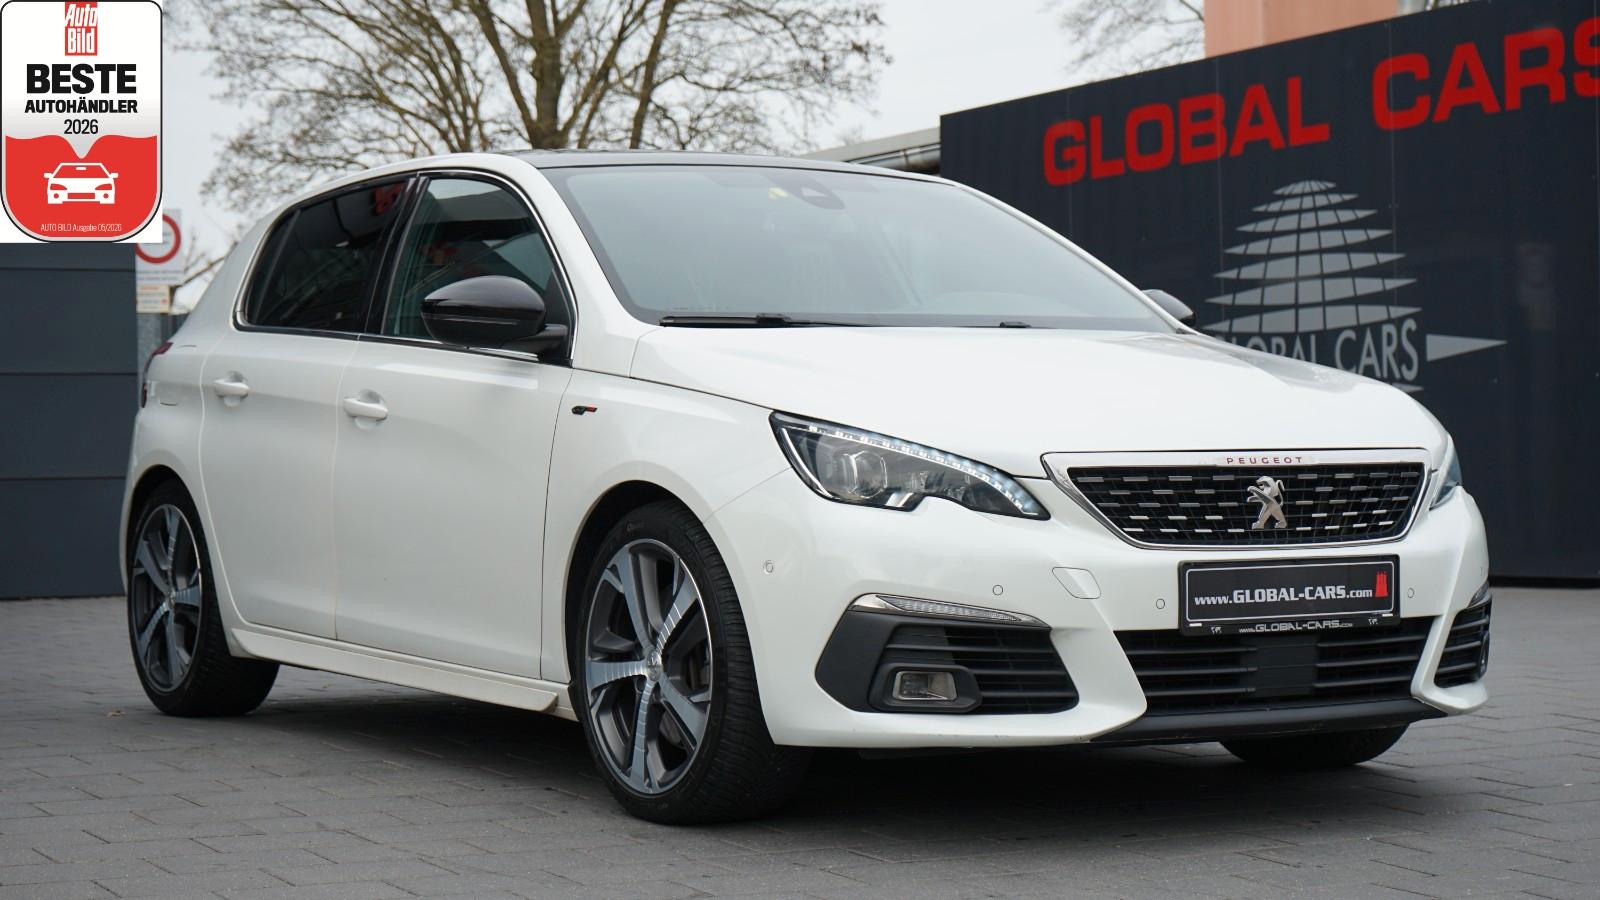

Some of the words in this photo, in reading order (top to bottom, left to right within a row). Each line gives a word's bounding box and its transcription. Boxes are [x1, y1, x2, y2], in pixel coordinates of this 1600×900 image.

[1043, 76, 1331, 187] GLOBAL
[1372, 16, 1600, 131] CARS
[1335, 318, 1419, 382] CARS
[1194, 585, 1373, 605] www.GLOBAL-CARS.com
